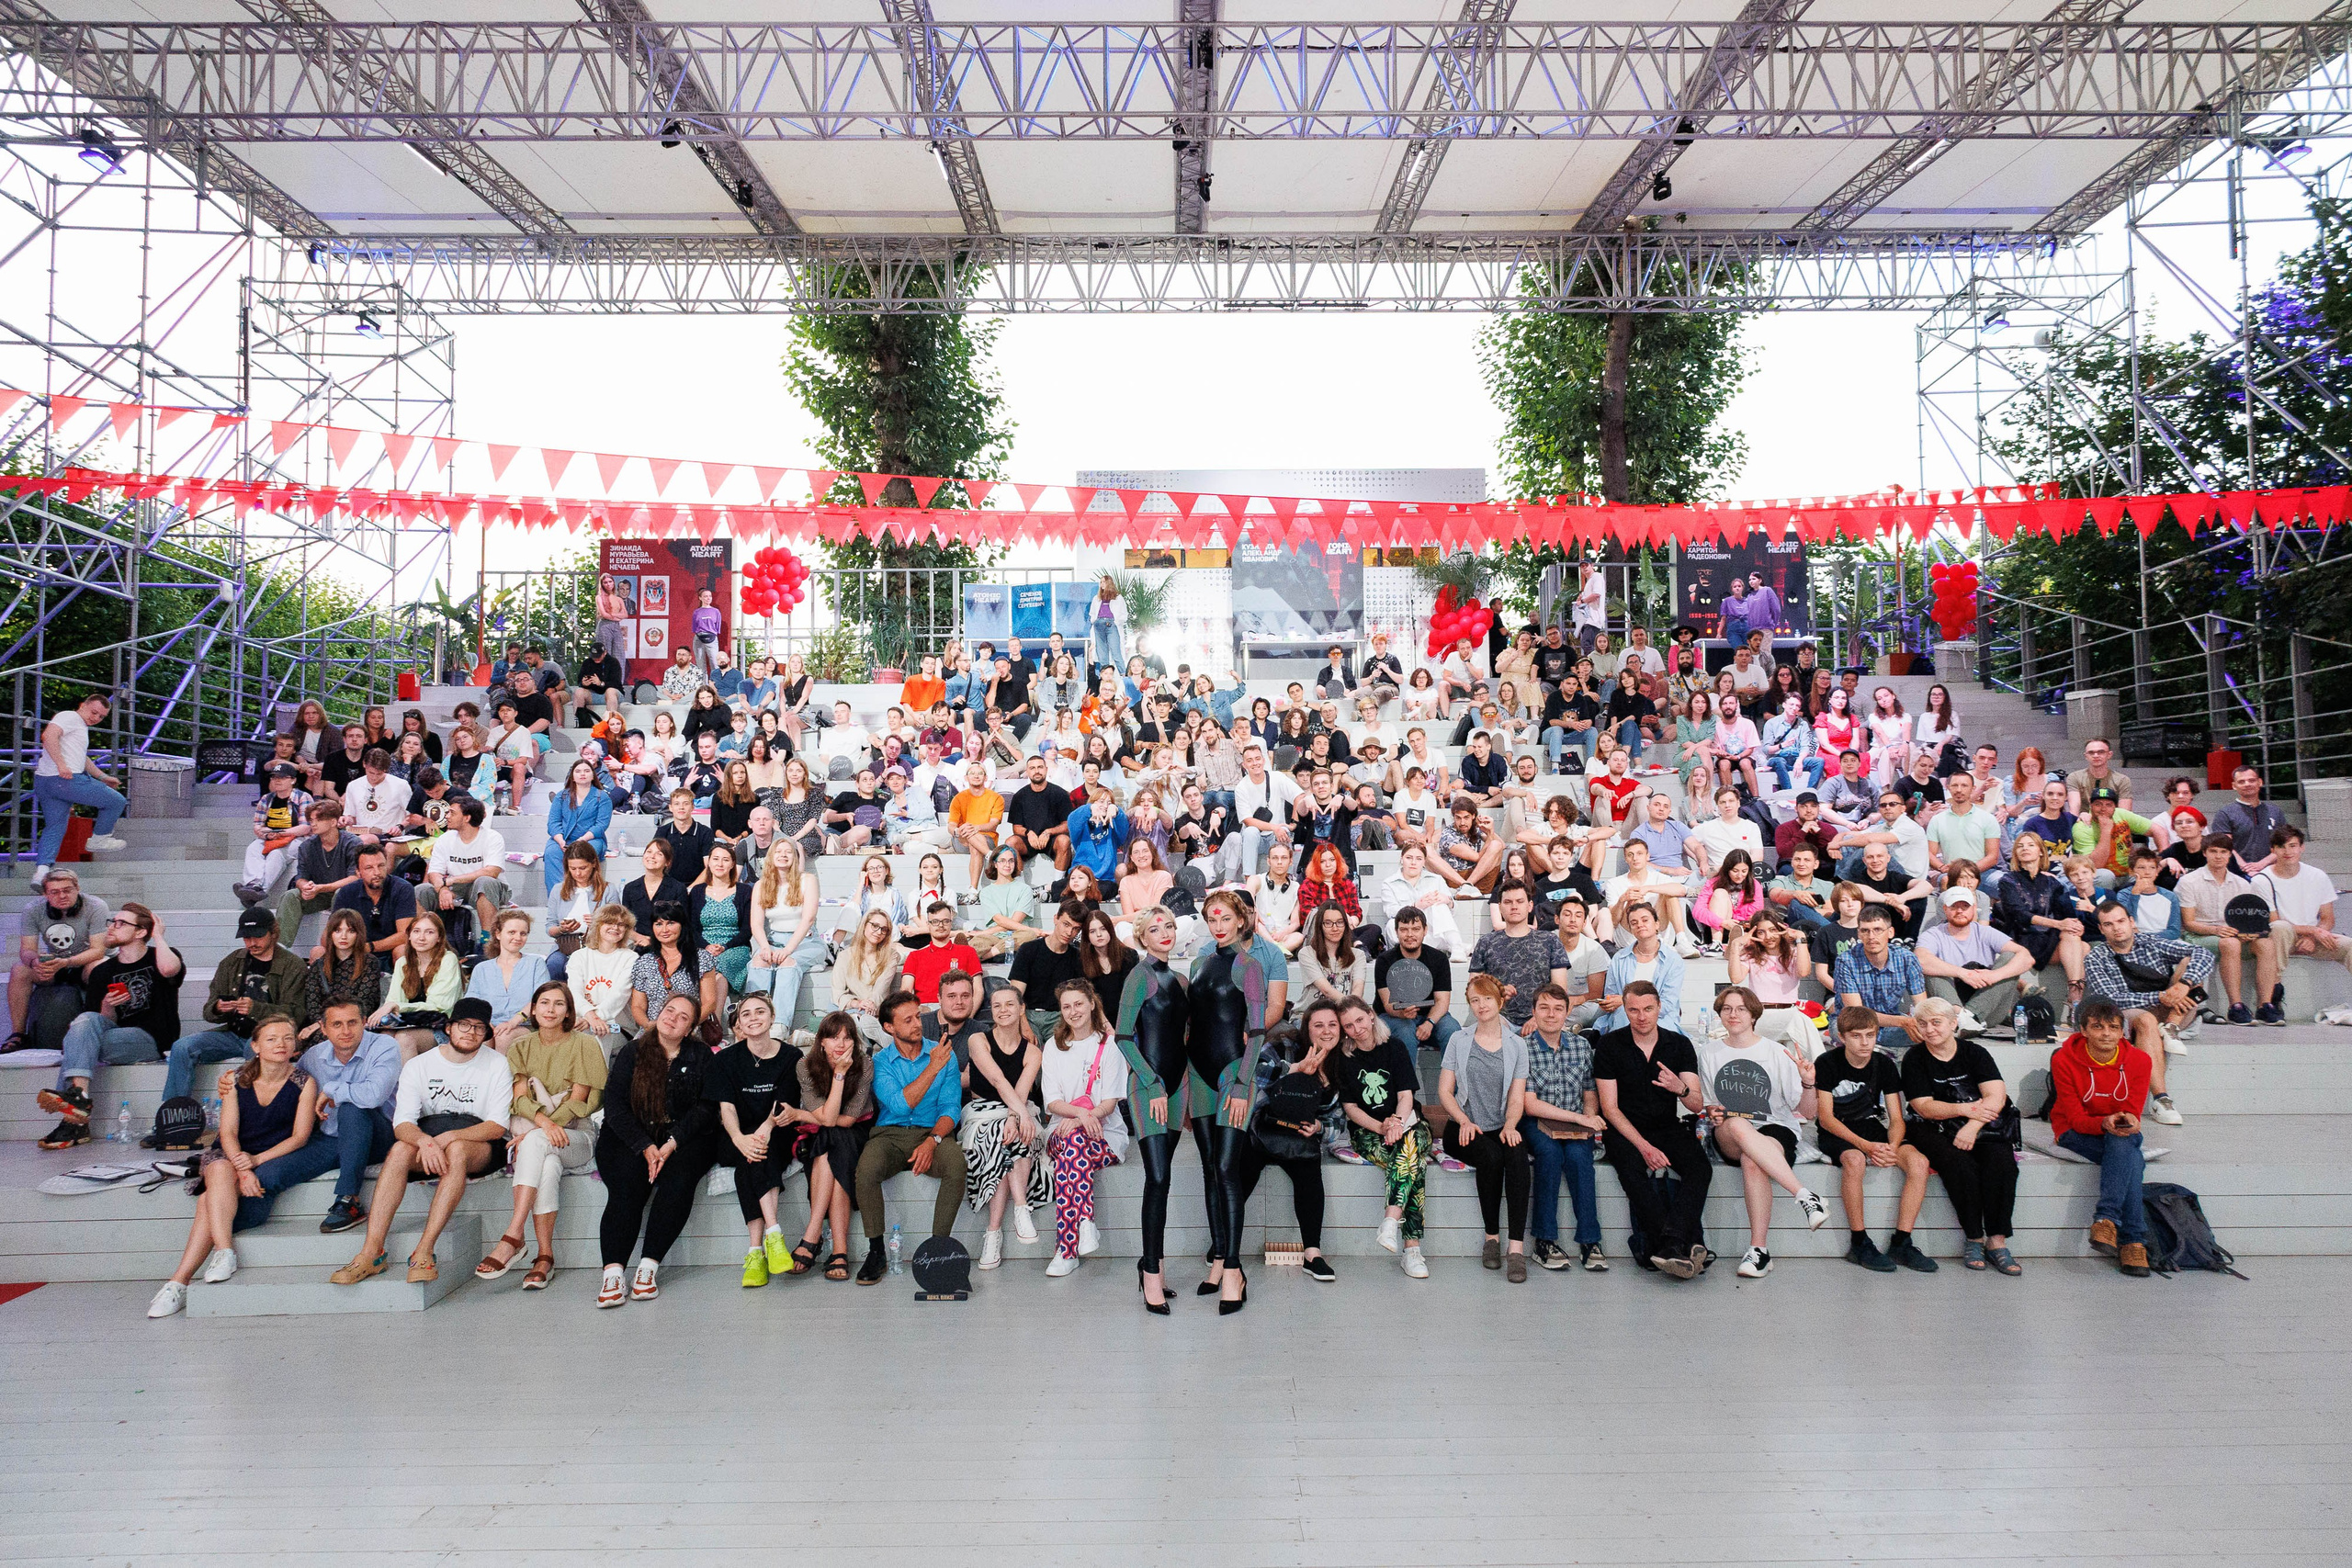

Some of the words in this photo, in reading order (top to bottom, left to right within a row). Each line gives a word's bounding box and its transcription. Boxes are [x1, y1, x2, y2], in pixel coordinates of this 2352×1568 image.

[449, 855, 484, 864] DEADPOO
[1720, 1078, 1770, 1100] ПИРОГИ
[162, 1105, 202, 1125] ПИЛОНЫ
